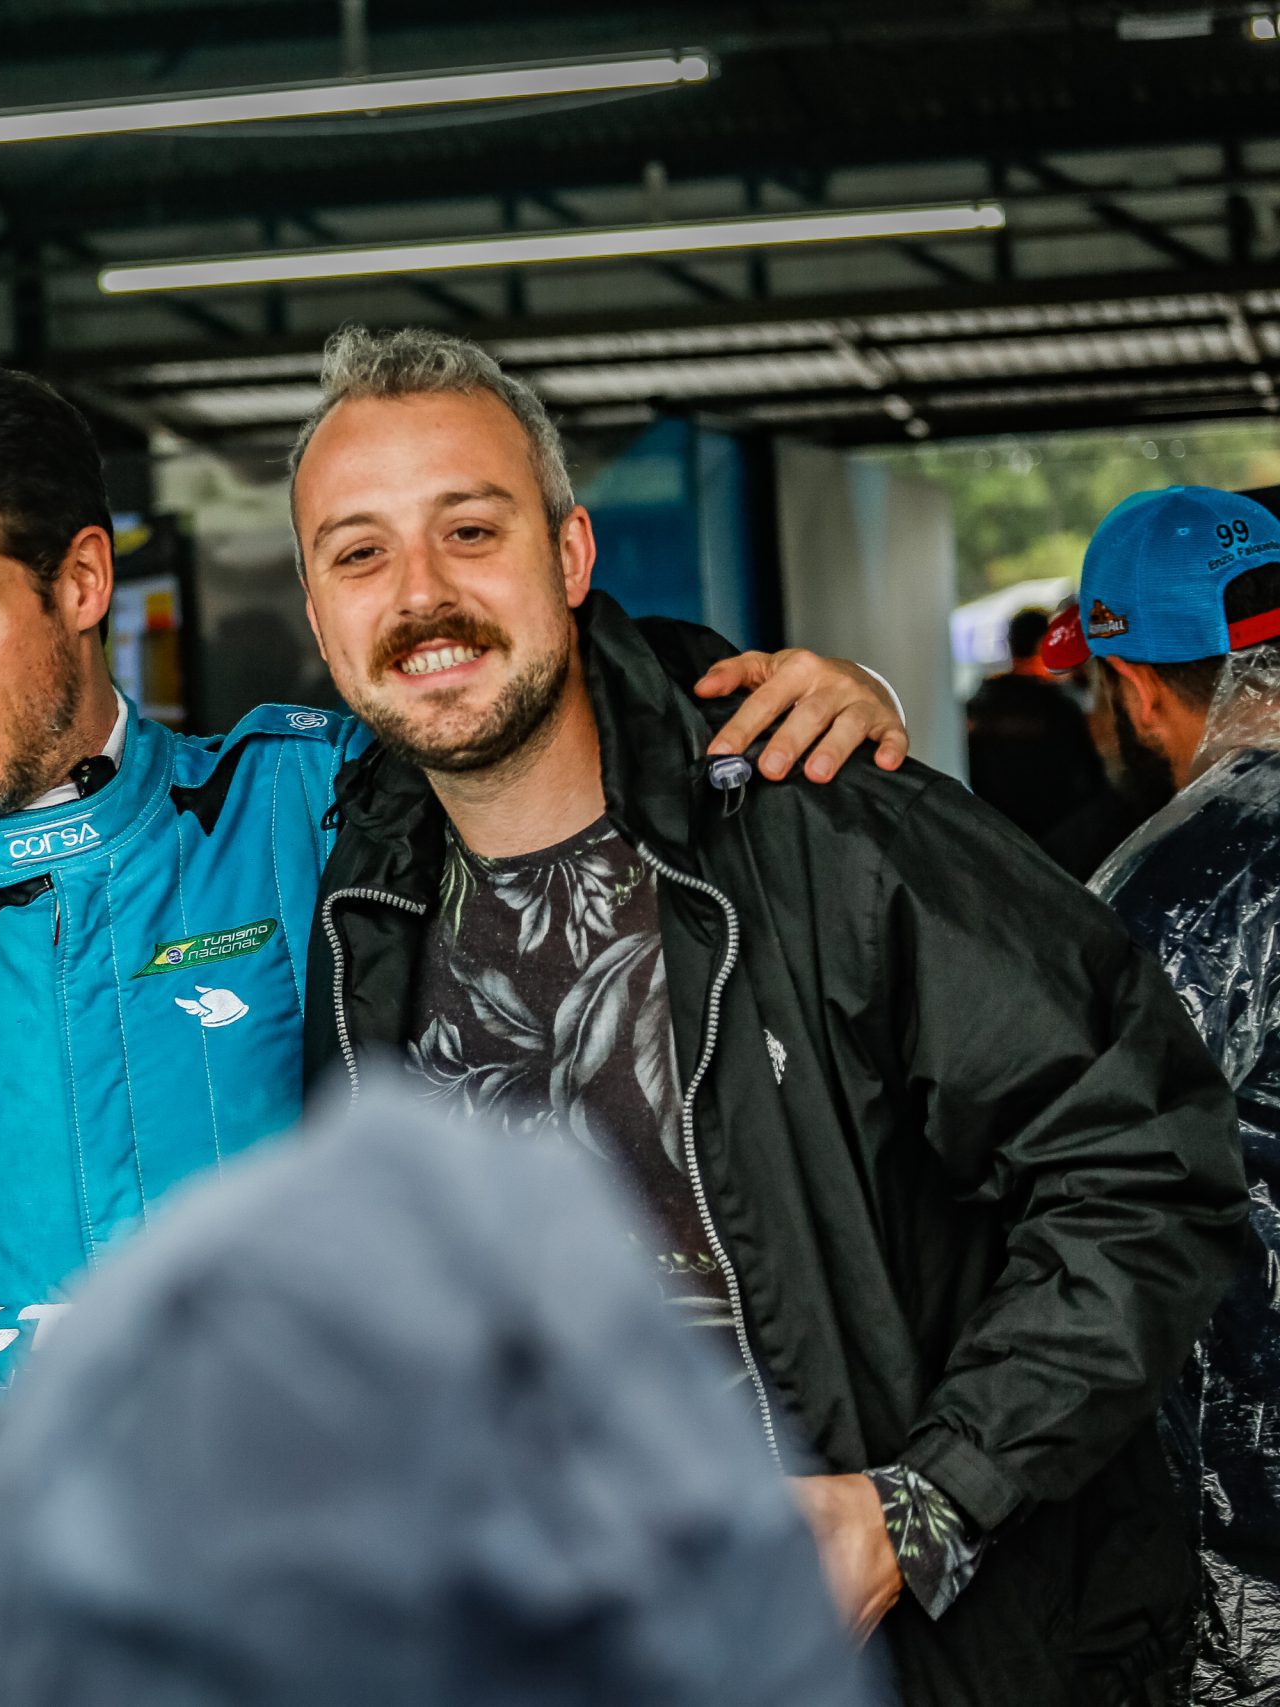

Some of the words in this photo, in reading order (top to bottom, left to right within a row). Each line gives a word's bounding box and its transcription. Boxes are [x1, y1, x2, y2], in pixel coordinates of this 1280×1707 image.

[1216, 519, 1249, 549] 99
[1207, 553, 1235, 571] Enzo
[202, 924, 268, 947] TURISMO
